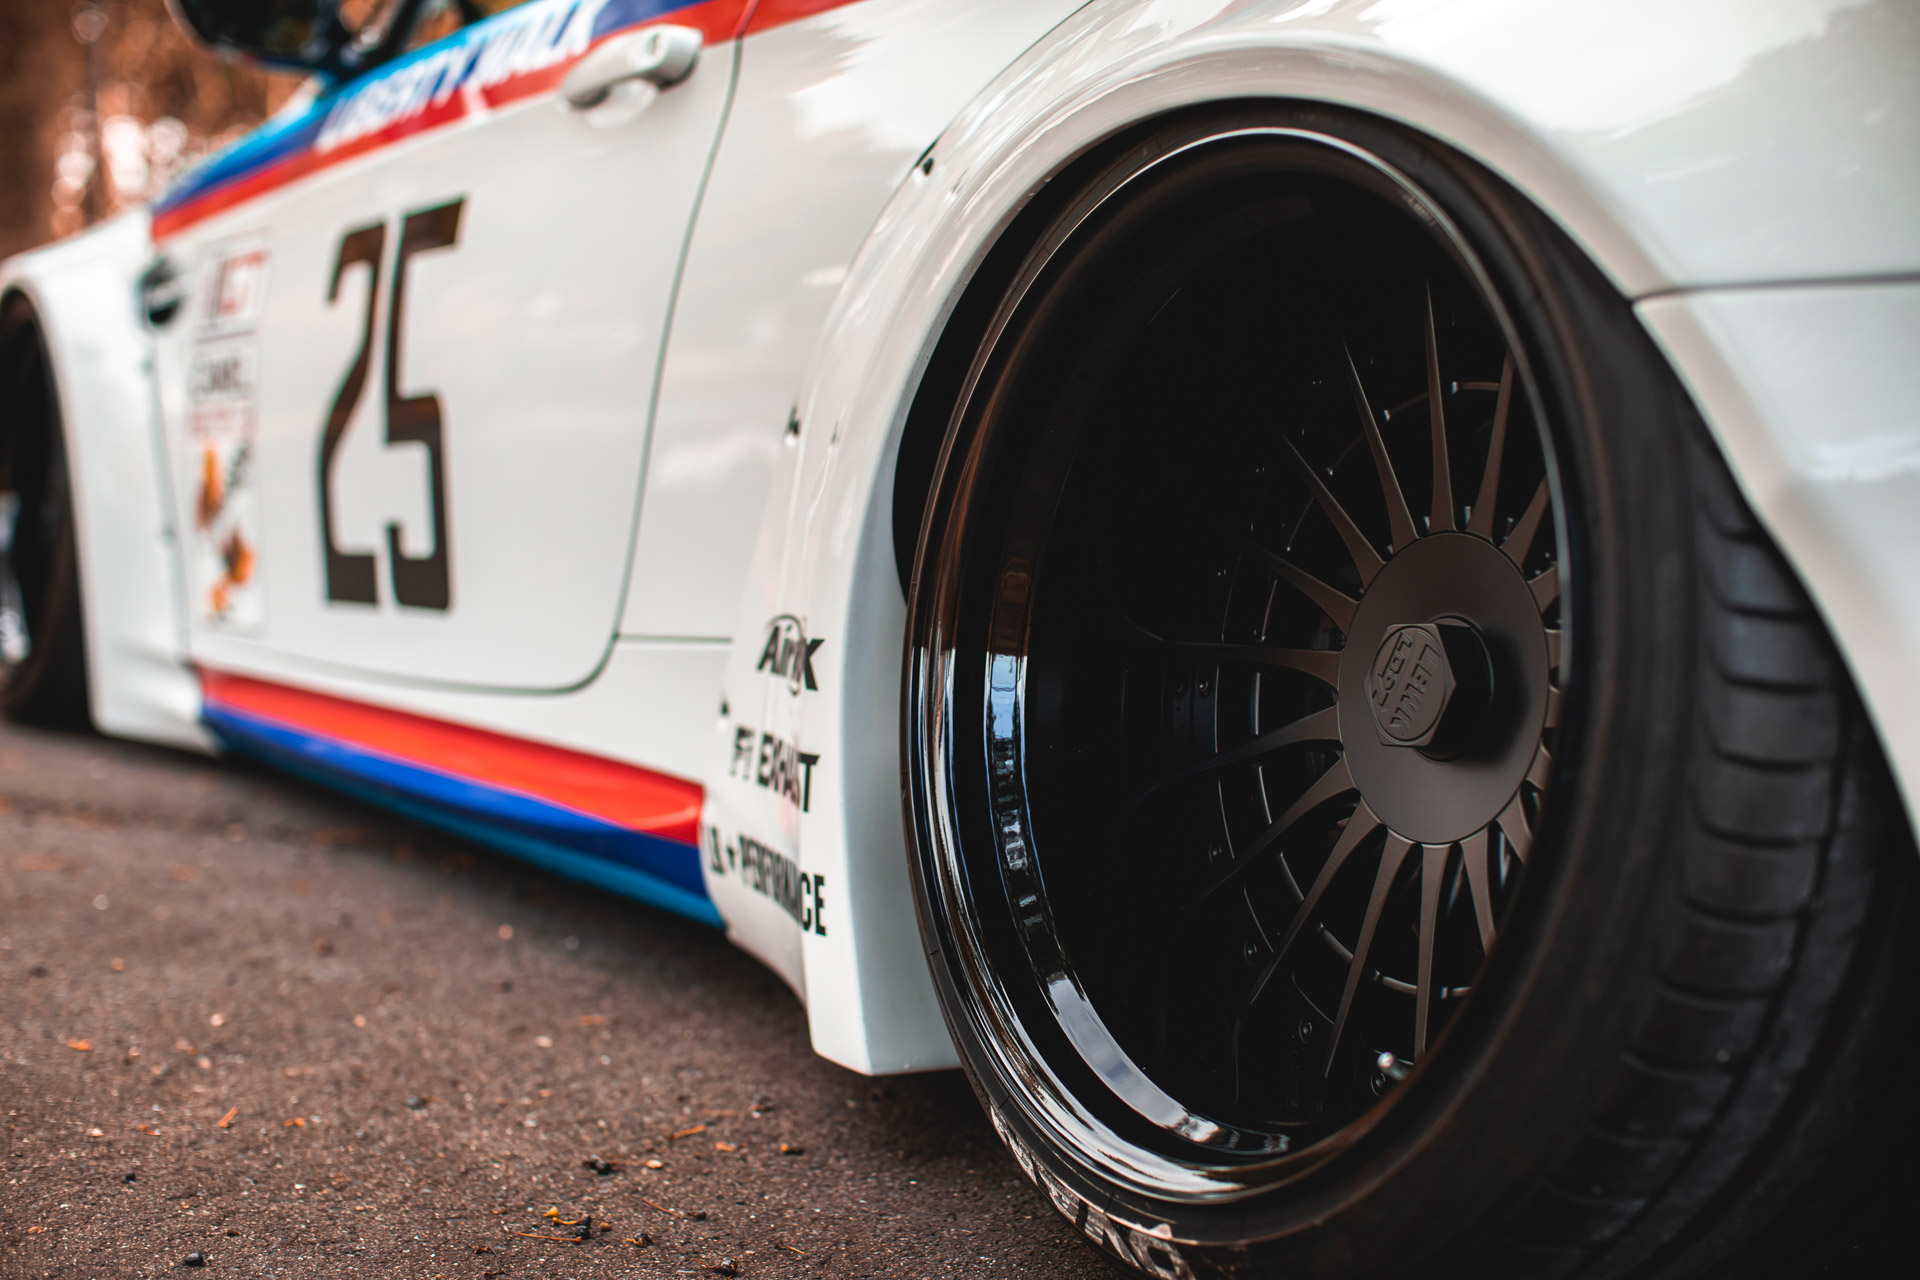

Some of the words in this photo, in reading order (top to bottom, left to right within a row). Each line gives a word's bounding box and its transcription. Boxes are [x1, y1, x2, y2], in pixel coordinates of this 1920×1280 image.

[318, 196, 467, 611] 25
[1389, 643, 1440, 736] LBWK
[738, 834, 826, 936] PERFCE
